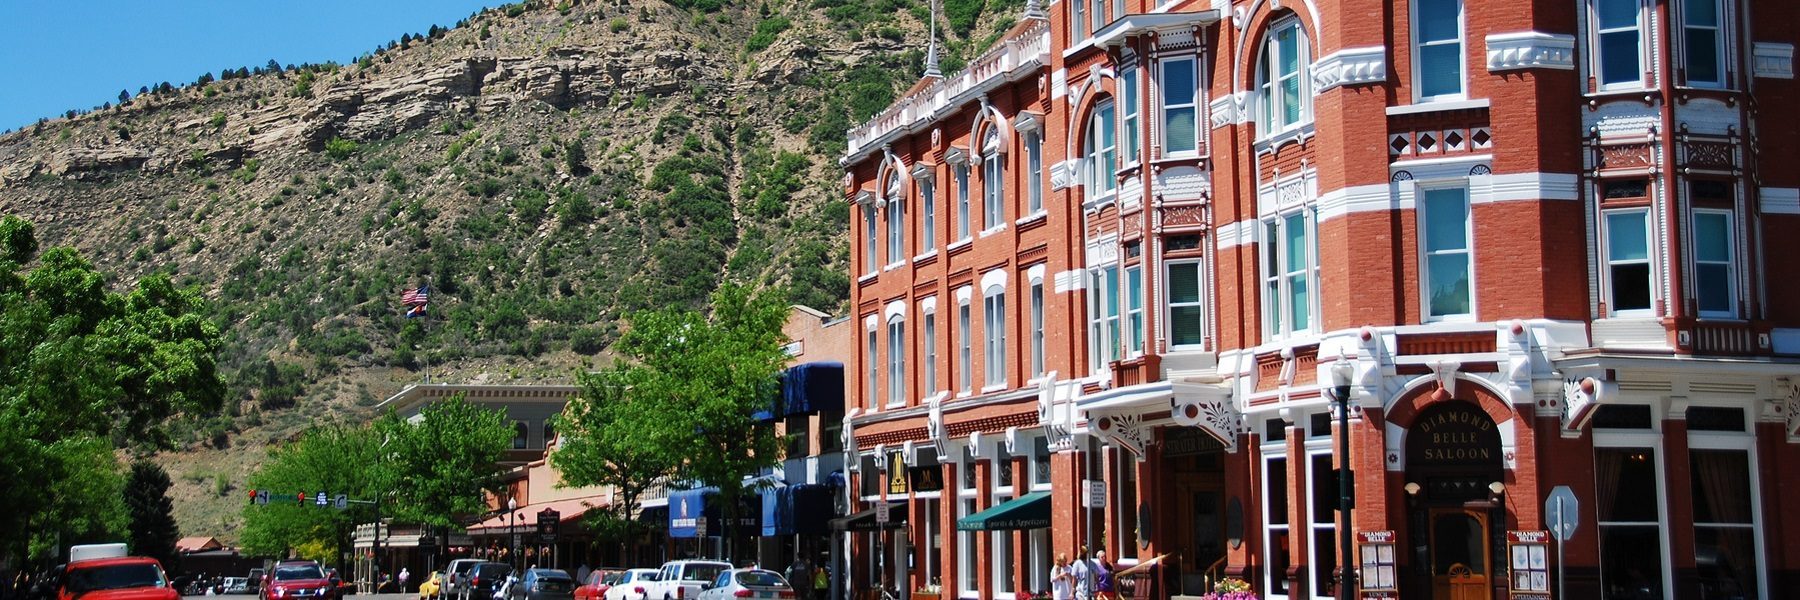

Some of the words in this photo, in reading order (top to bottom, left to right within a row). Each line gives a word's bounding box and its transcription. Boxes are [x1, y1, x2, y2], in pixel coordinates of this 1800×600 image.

[1420, 411, 1490, 432] DIAMOND
[1433, 432, 1477, 443] BELLE
[1425, 448, 1489, 460] SALOON
